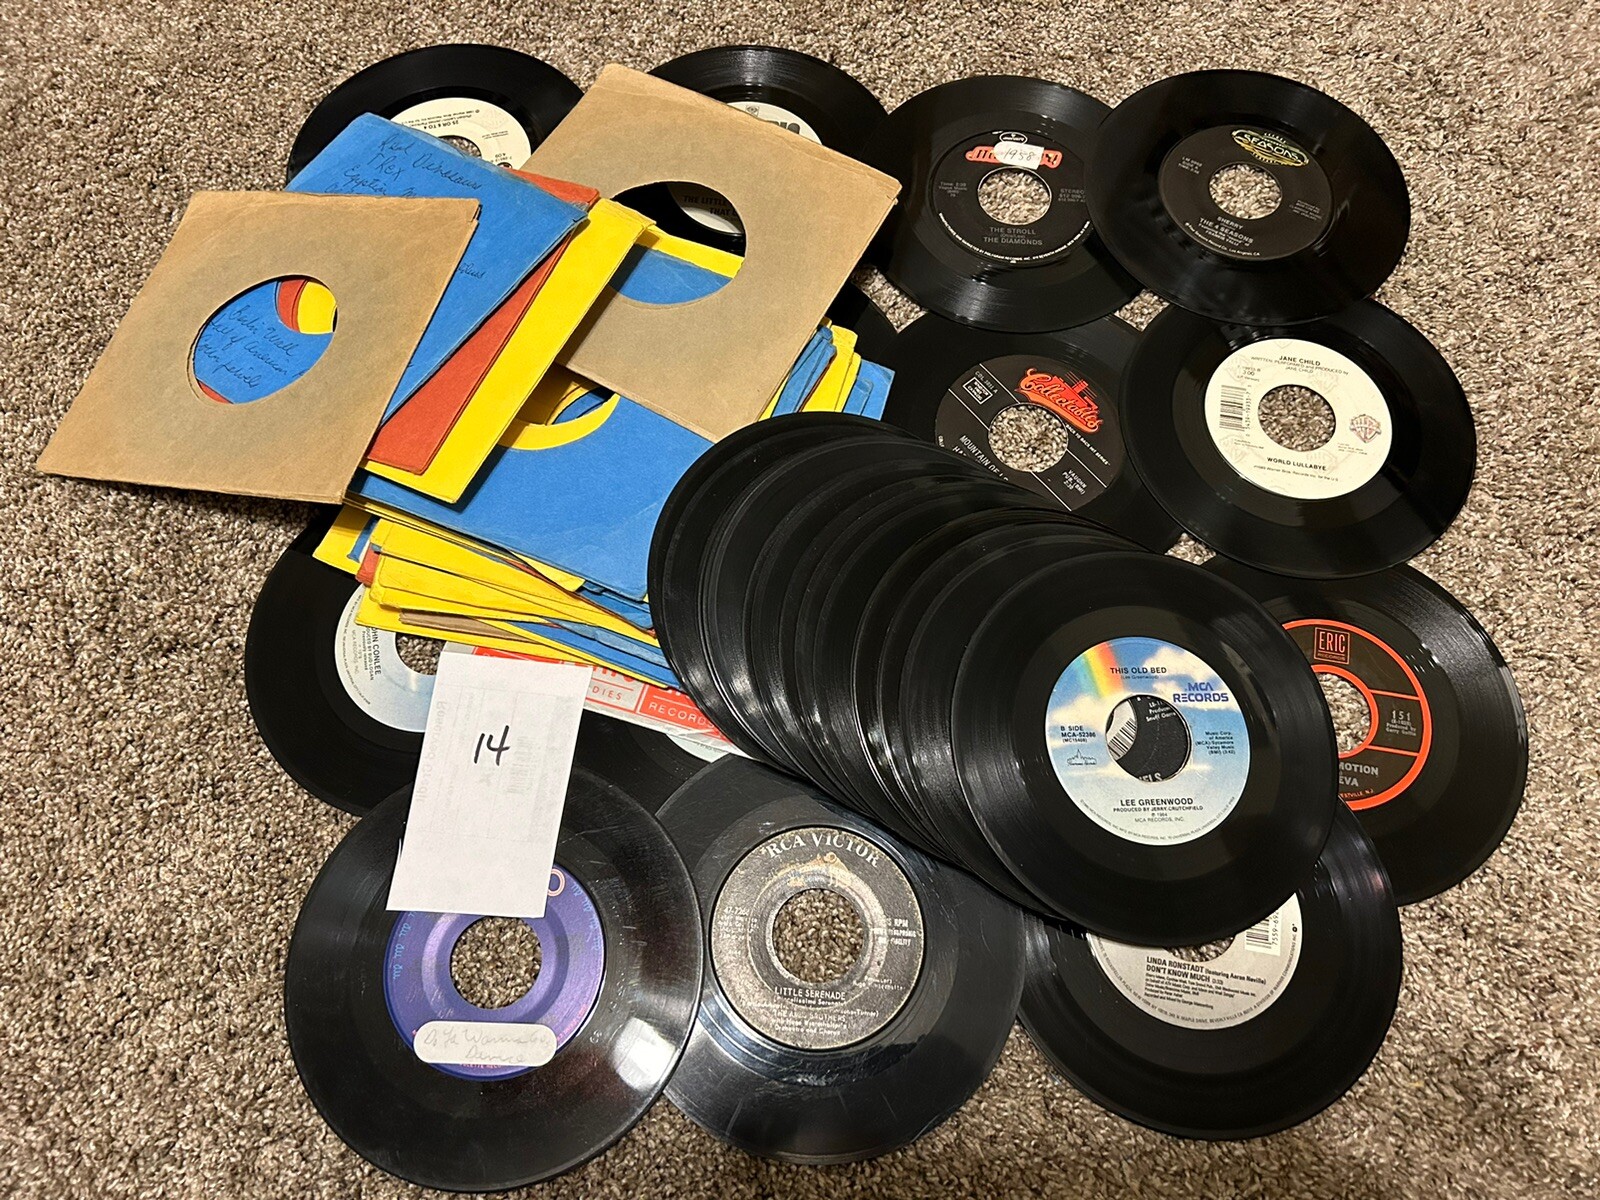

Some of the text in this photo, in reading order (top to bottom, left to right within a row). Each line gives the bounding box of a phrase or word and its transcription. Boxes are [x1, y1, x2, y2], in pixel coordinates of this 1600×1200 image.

[1003, 147, 1037, 162] 1958
[1243, 133, 1299, 161] SEASONS
[683, 195, 698, 204] THE
[709, 207, 730, 217] THAT
[990, 226, 1037, 235] THE STROLL
[1199, 216, 1215, 228] THE
[1219, 226, 1254, 244] SEASONS
[1216, 216, 1244, 230] SHERRY
[983, 236, 1043, 246] THE DIAMONDS
[1279, 355, 1321, 367] JANE CHILD
[1018, 367, 1104, 430] Collectables
[959, 434, 992, 467] MOUNTAIN
[1266, 456, 1327, 472] WORLD LULLABYE
[1318, 630, 1347, 654] ERIC
[372, 644, 382, 676] CONLEE
[1109, 666, 1167, 674] THIS OLD BED
[591, 685, 623, 701] DIES
[1172, 682, 1229, 703] MCA RECORDS
[648, 701, 715, 730] RECORDS
[472, 724, 512, 767] 14
[1119, 797, 1194, 807] LEE GREENWOOD
[765, 832, 880, 869] RCA VICTOR
[893, 918, 909, 928] RPM
[1145, 964, 1211, 983] DON'T KNOW MUCH
[1146, 955, 1168, 967] LINDA
[1167, 959, 1205, 974] RONSTADT
[1229, 972, 1246, 982] Aaron
[773, 985, 847, 1001] LITTLE SERENADE
